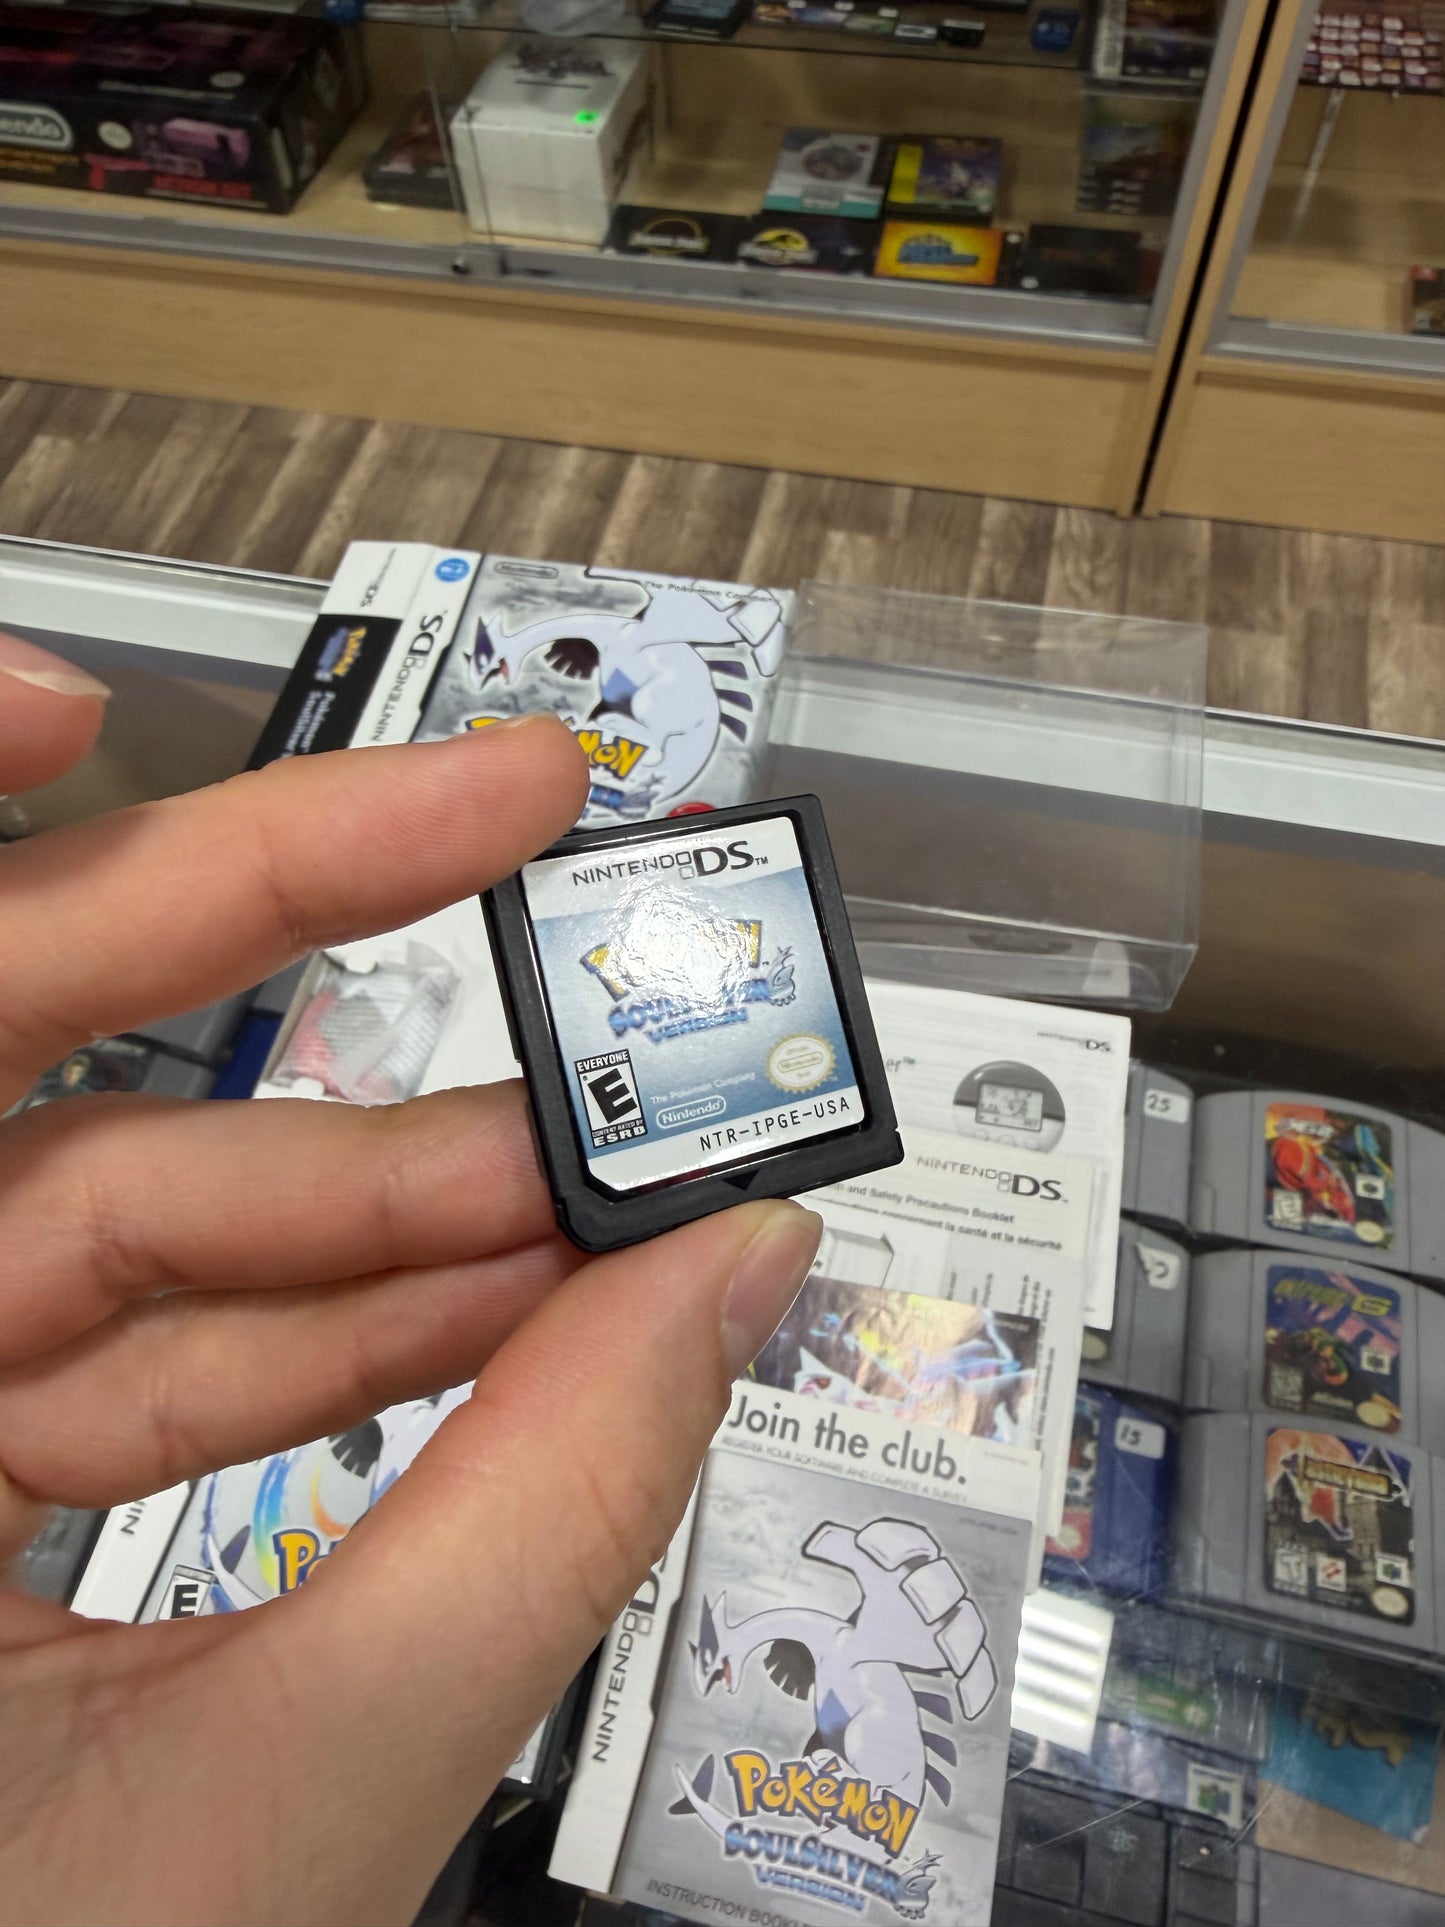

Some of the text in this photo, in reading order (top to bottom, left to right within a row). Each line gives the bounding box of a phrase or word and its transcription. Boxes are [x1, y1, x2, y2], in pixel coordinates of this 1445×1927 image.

[572, 851, 692, 886] NINTENDO
[576, 1050, 629, 1073] EVERYONE
[587, 1067, 638, 1125] E
[650, 1095, 668, 1105] The
[1147, 1093, 1171, 1113] 25
[593, 1125, 646, 1147] ESRB
[699, 1096, 850, 1151] NTR-IPGE-USA
[916, 1155, 1012, 1183] NINTENDO
[869, 1187, 904, 1203] Safety
[904, 1195, 970, 1216] Precautions
[971, 1207, 1016, 1225] Booklet
[727, 1395, 967, 1486] Join the club.
[592, 1611, 640, 1763] NINTENDO
[646, 1879, 748, 1920] INSTRUCTION
